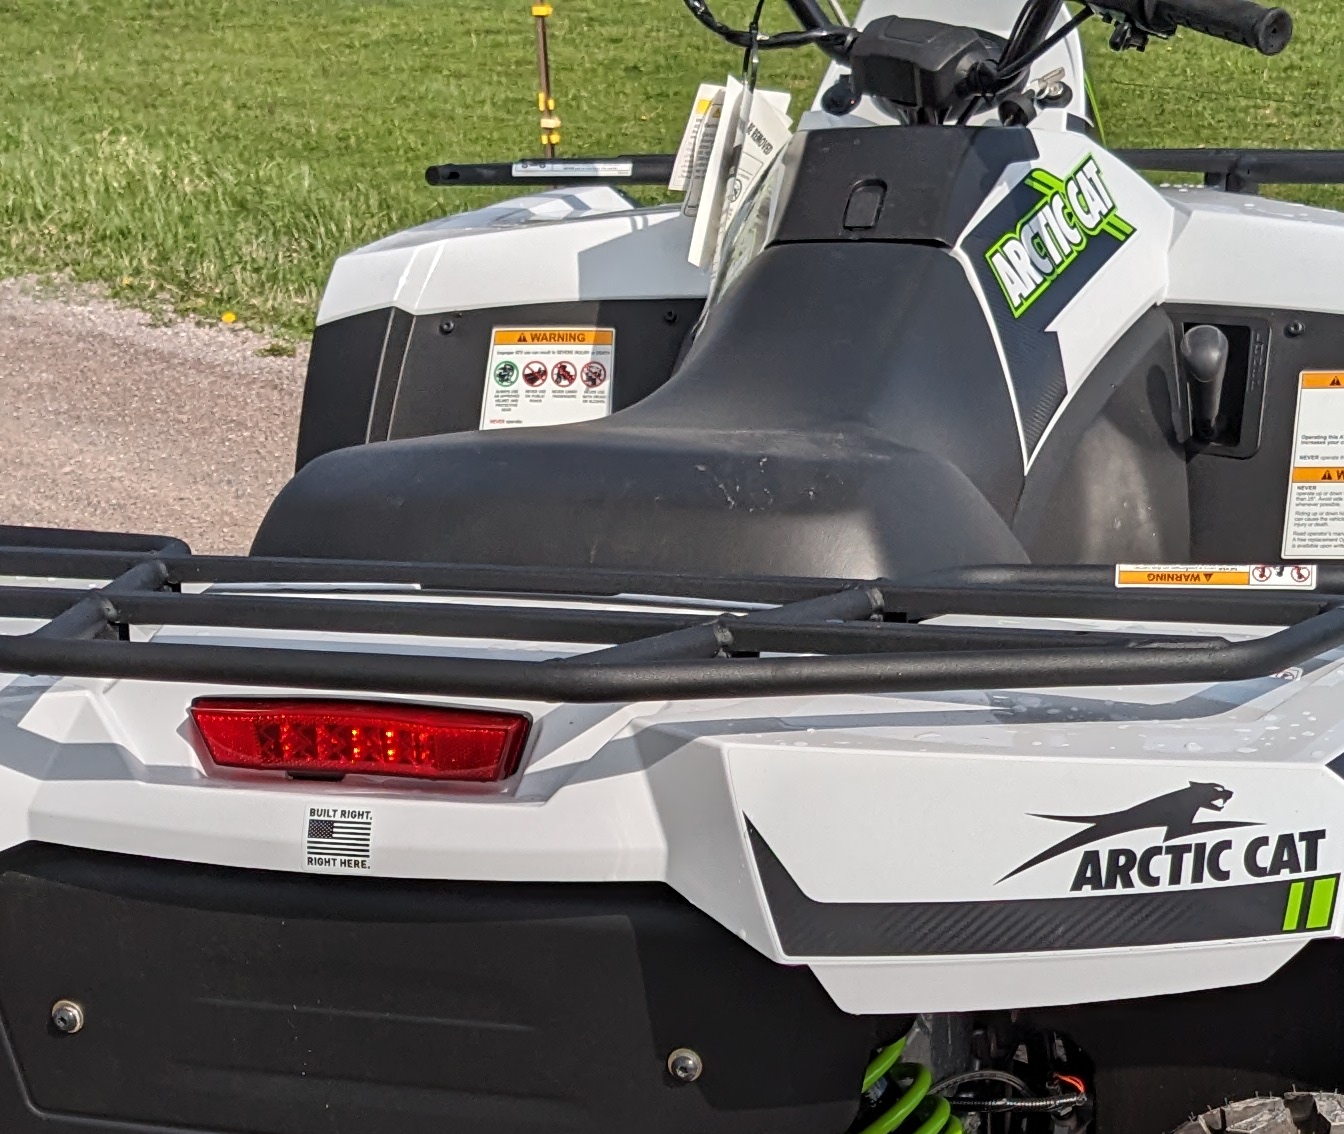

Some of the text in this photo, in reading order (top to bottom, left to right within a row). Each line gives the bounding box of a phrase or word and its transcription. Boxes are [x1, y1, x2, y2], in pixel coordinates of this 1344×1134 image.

[750, 128, 774, 155] REMOVED
[991, 159, 1114, 308] ARCTIC CAT
[529, 333, 586, 343] WARNING
[1147, 572, 1200, 582] WARNING
[309, 808, 373, 821] BUILT RIGHT.
[307, 856, 371, 870] RIGHT HERE.
[1069, 828, 1327, 892] ARCTIC CAT
